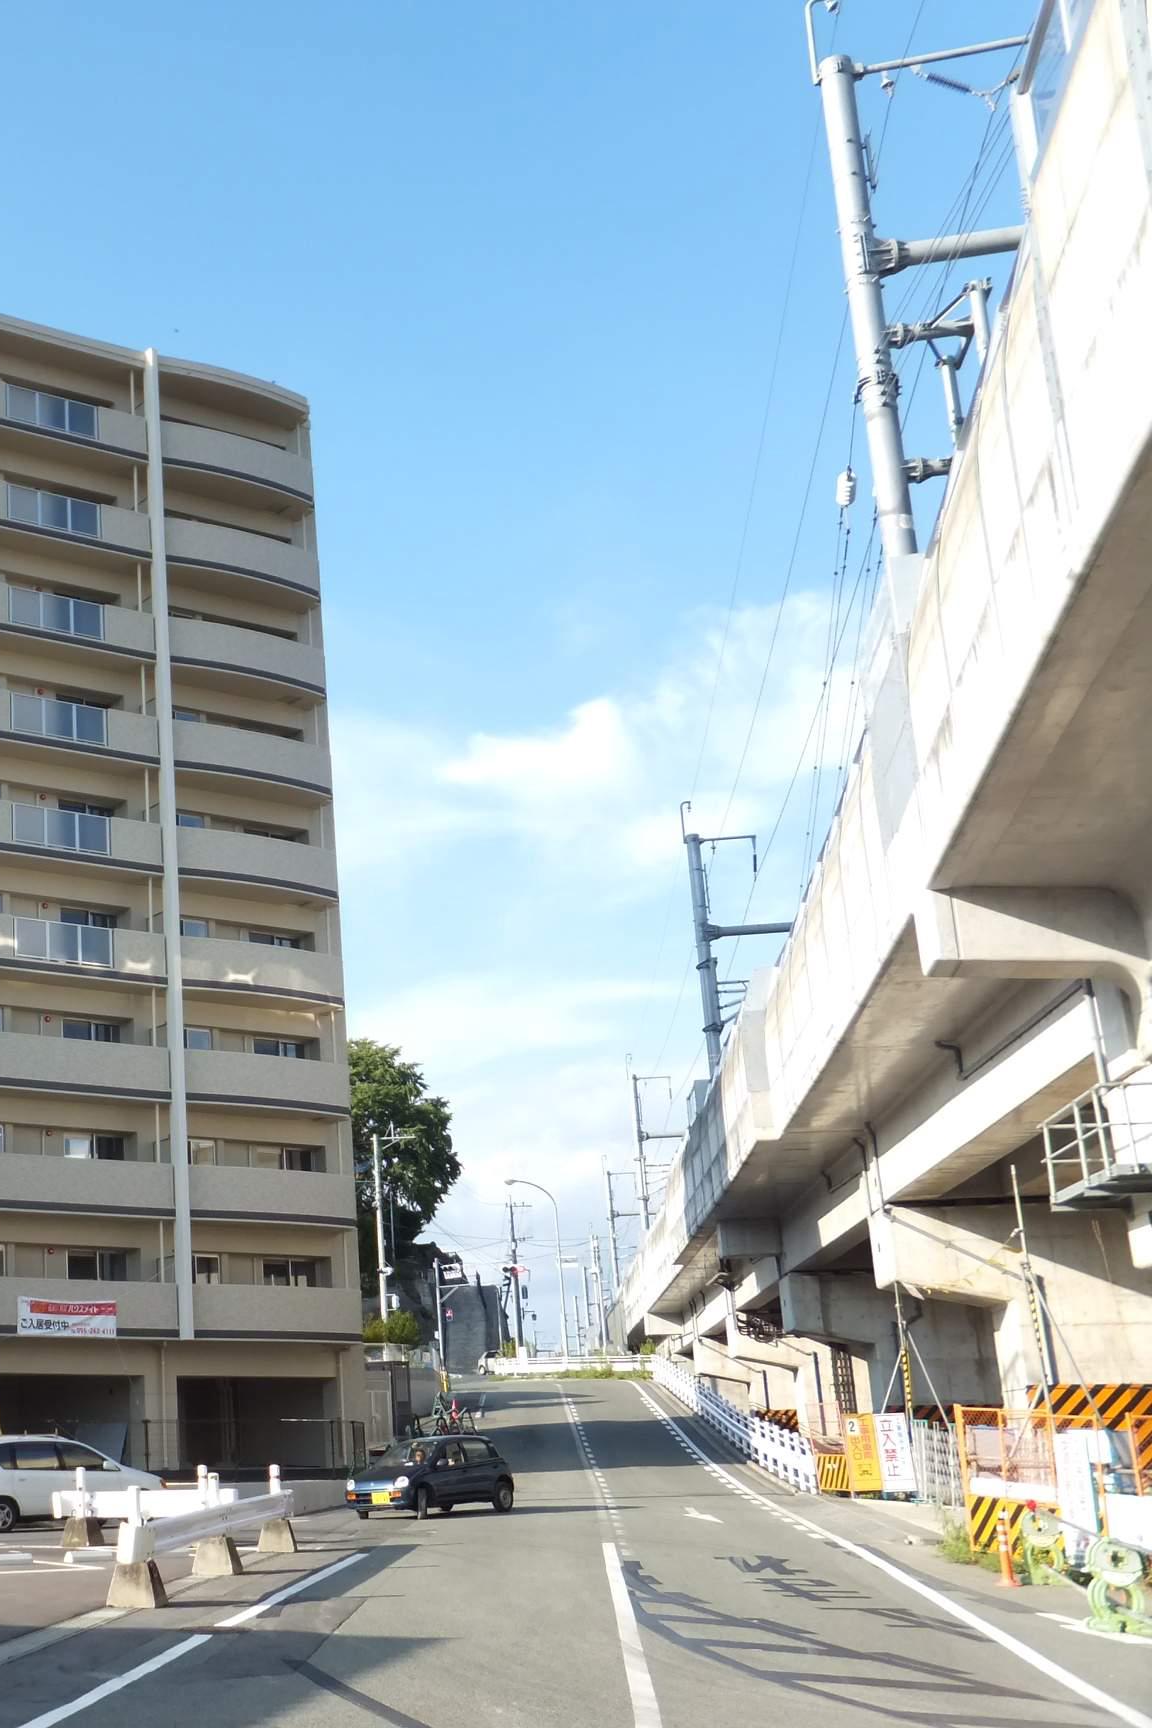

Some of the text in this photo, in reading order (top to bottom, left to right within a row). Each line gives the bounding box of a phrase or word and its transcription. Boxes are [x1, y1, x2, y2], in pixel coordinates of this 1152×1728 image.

[20, 1317, 70, 1331] ご入居受付中
[848, 1420, 856, 1432] 2
[879, 1418, 902, 1477] 立入禁止
